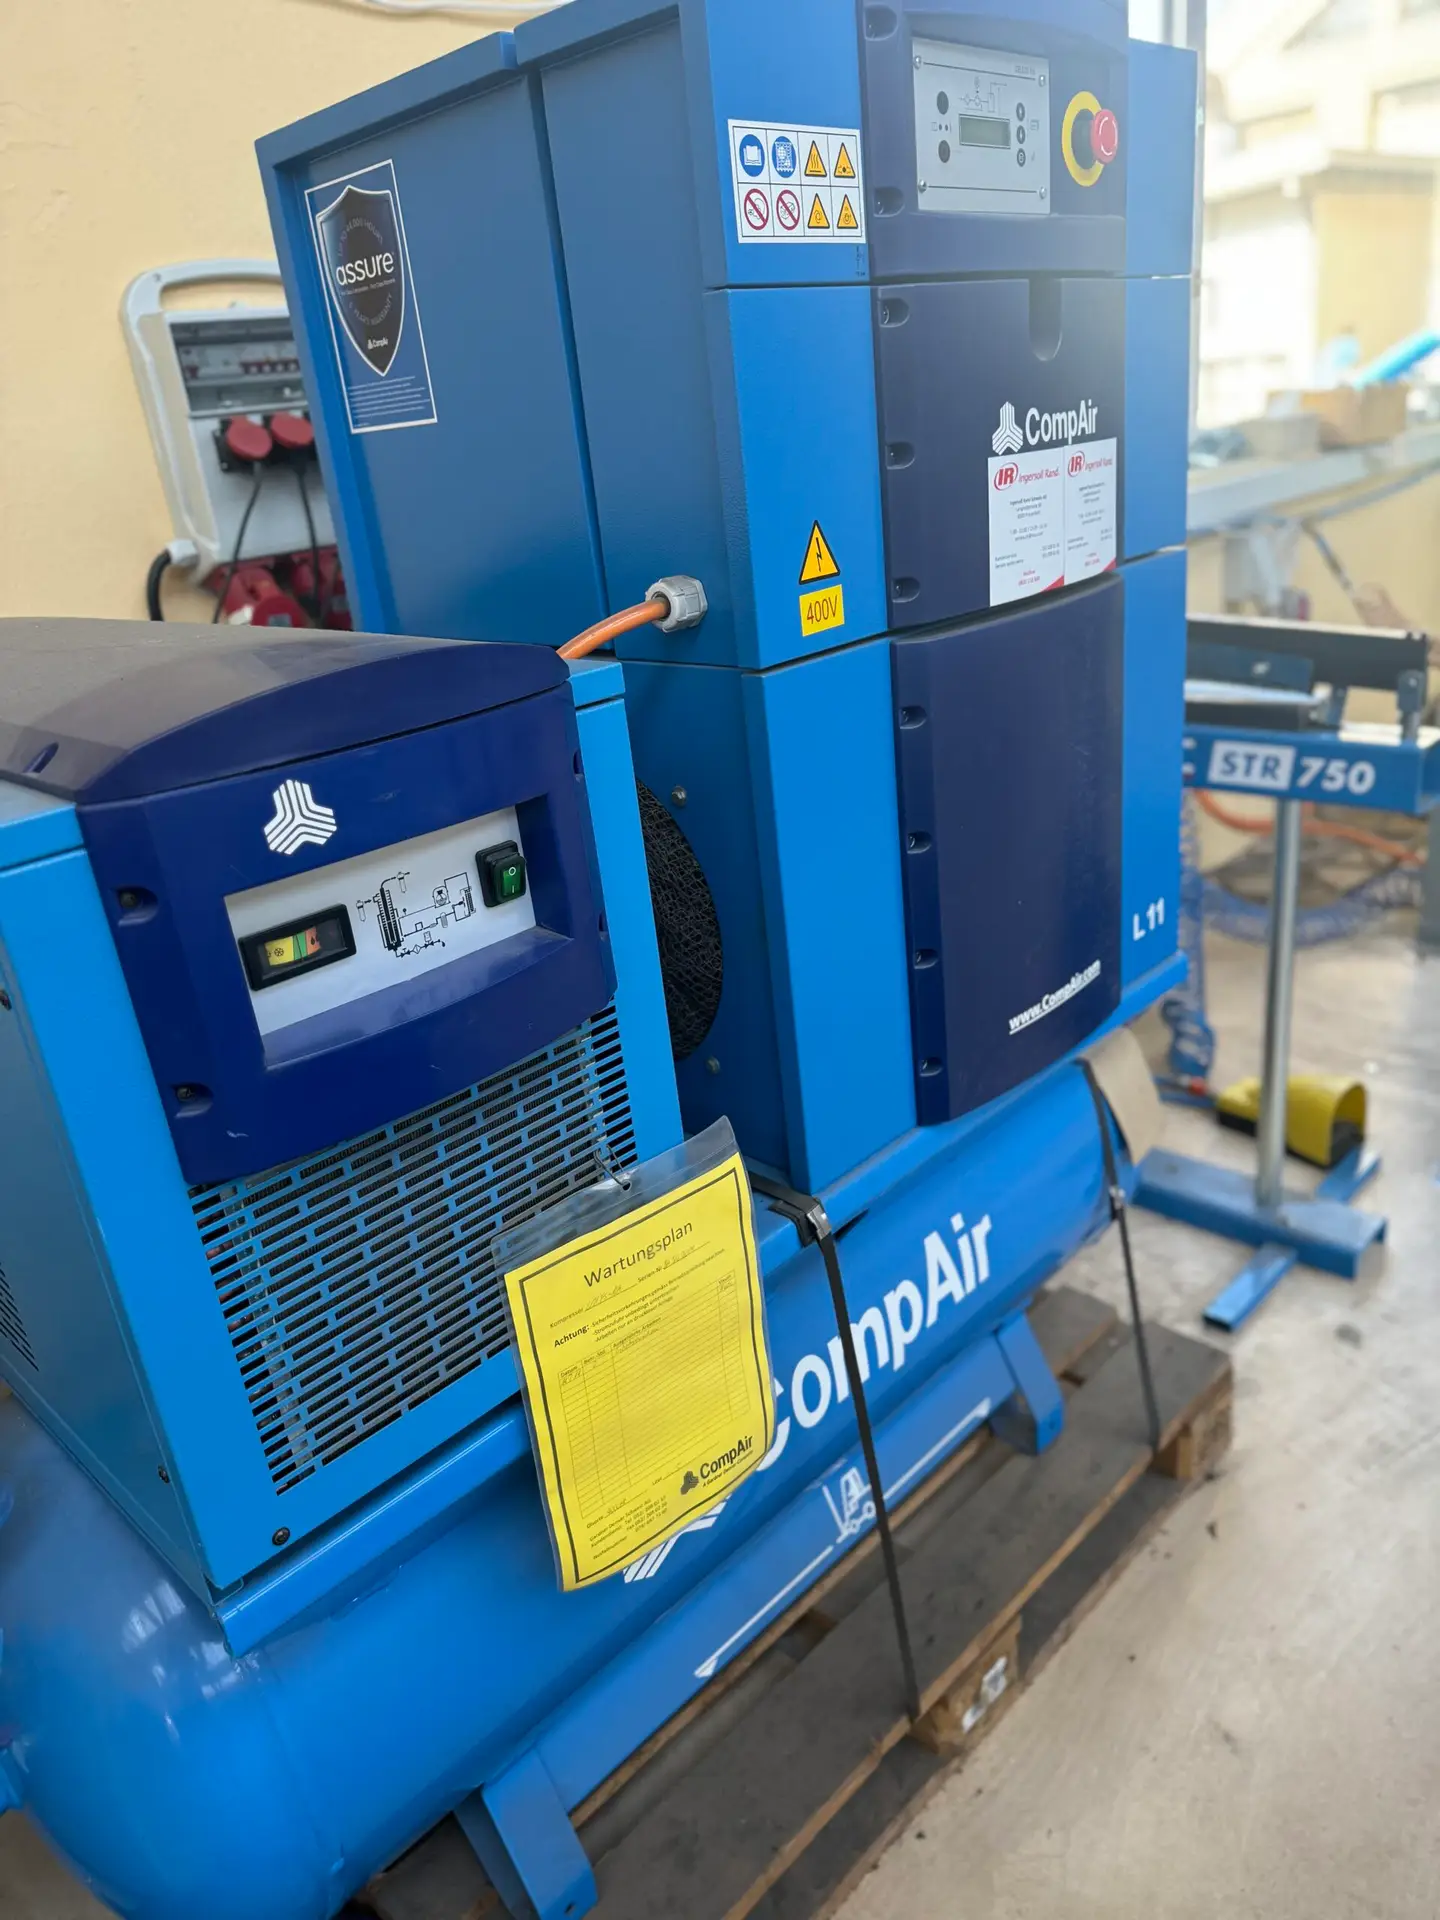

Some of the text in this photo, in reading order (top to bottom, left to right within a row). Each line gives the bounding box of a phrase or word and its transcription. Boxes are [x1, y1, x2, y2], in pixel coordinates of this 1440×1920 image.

[336, 252, 394, 286] assure
[1025, 399, 1098, 446] CompAir
[998, 467, 1015, 486] IR
[1018, 469, 1044, 485] Ingersoll
[1070, 455, 1082, 473] IR
[807, 595, 838, 624] 400V
[1220, 751, 1281, 781] STR
[1296, 756, 1376, 794] 750
[1133, 897, 1164, 941] L 11
[1008, 959, 1101, 1034] www.CompAir.com
[584, 1223, 692, 1287] Wartungsplan
[555, 1325, 589, 1347] Achtung:
[700, 1436, 752, 1479] CompAir
